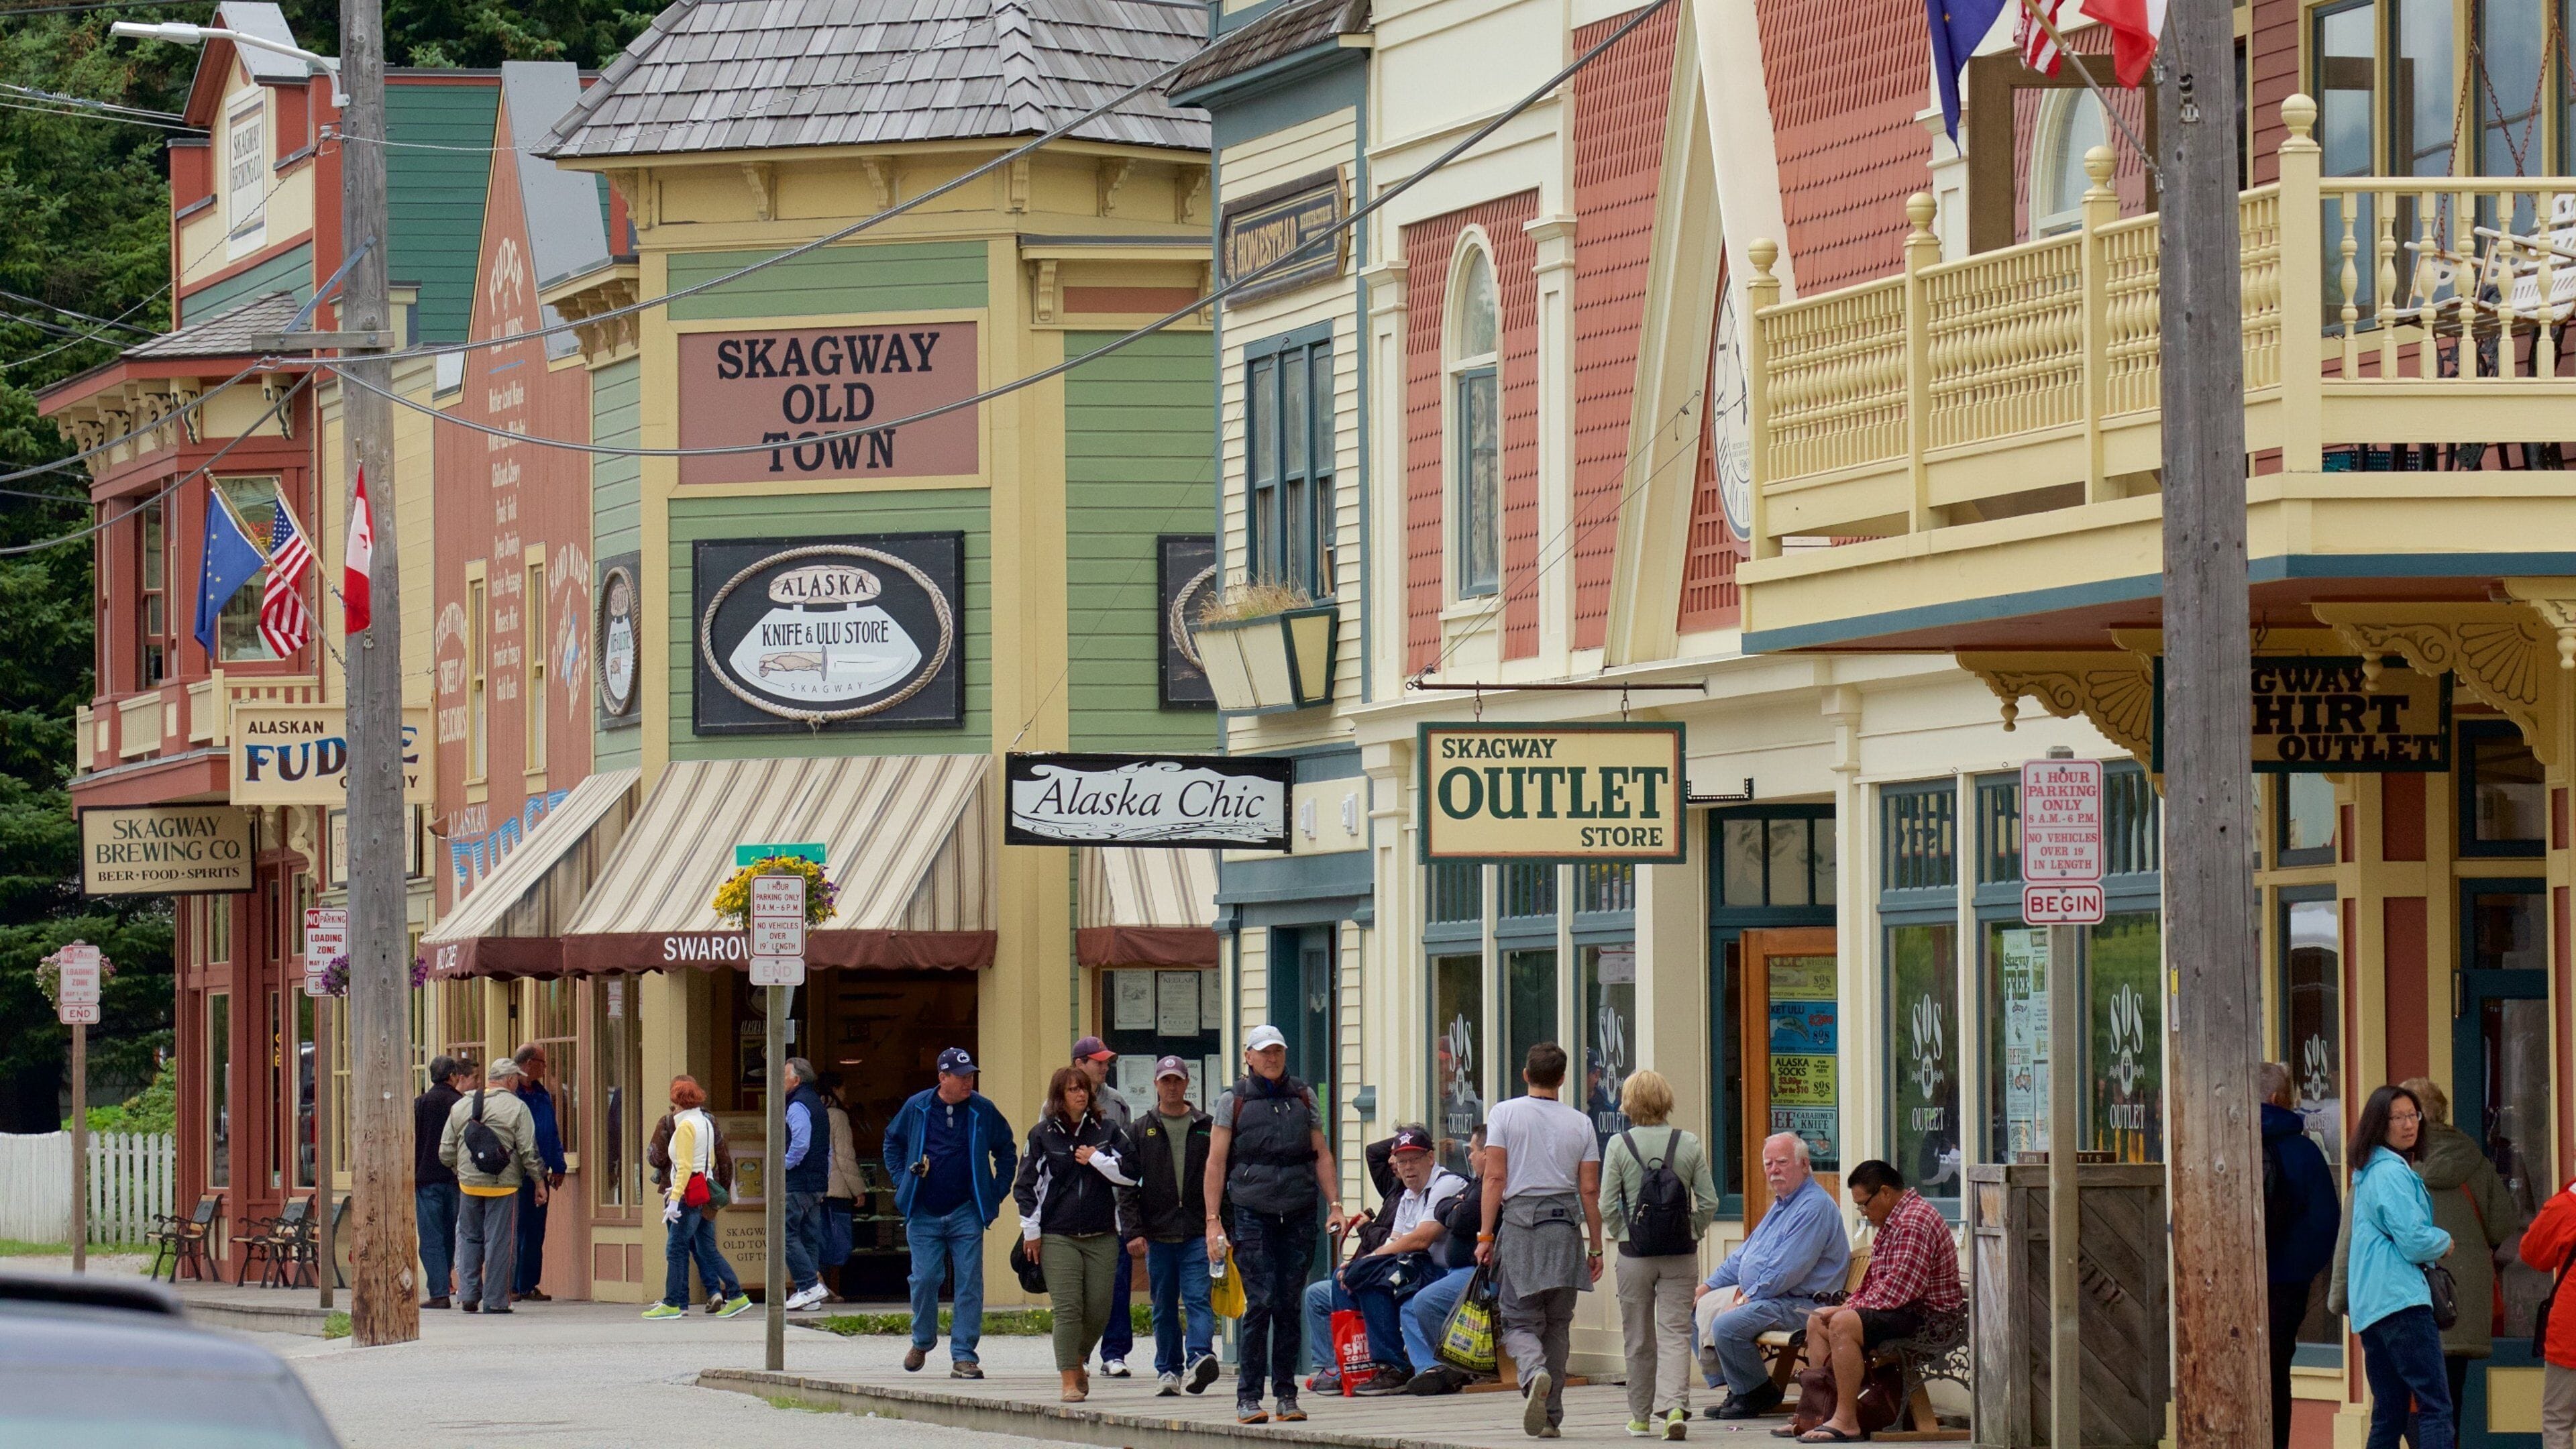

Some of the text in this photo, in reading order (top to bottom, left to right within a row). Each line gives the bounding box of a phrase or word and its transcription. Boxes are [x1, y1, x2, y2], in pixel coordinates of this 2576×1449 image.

[233, 123, 260, 161] SKAGWAY
[232, 154, 263, 193] BREWING CO.
[1236, 215, 1297, 274] HOMESTEAD
[490, 237, 523, 317] FUDGE
[491, 315, 523, 355] ALL KINDS
[718, 332, 939, 380] SKAGWAY
[782, 382, 874, 424] OLD
[762, 429, 896, 472] TOWN
[549, 545, 568, 603] HAND
[570, 542, 588, 597] MADE
[781, 574, 867, 596] ALASKA
[552, 585, 571, 684] RIGHT
[762, 620, 889, 646] KNIFE & ULU STORE
[570, 631, 587, 722] HERE
[791, 681, 863, 694] SKAGWAY
[2251, 667, 2365, 694] GWAY
[438, 705, 466, 745] DELICIOUS
[2251, 694, 2410, 735] HIRT
[248, 720, 324, 734] ALASKAN
[246, 727, 419, 782] FUDE
[1442, 738, 1557, 759] SKAGWAY
[2277, 734, 2438, 762] OUTLET
[2034, 771, 2090, 784] 1 HOUR
[1031, 777, 1265, 818] Alaska Chic
[1438, 766, 1668, 820] OUTLET
[2028, 786, 2097, 797] PARKING
[2042, 799, 2083, 810] ONLY
[113, 816, 221, 840] SKAGWAY
[447, 805, 488, 839] ALASKAN
[2028, 814, 2034, 824] 8
[2078, 813, 2097, 822] P.M.
[1581, 826, 1663, 847] STORE
[2028, 833, 2097, 843] NO VEHICLES
[96, 840, 241, 864] BREWING CO.
[2041, 847, 2068, 856] OVER
[99, 867, 239, 881] BEER FOOD SPIRITS
[2034, 859, 2092, 870] IN LENGTH
[2031, 896, 2097, 913] BEGIN
[307, 913, 345, 925] NO PARKING
[311, 934, 343, 942] LOADING
[317, 946, 336, 954] ZONE
[762, 966, 792, 977] END
[70, 1009, 91, 1018] END
[1770, 1005, 1805, 1014] KET ULU
[2110, 983, 2143, 1055] SOS
[740, 1020, 761, 1036] ALASKA
[1599, 1006, 1625, 1069] SOS
[1913, 994, 1943, 1061] SOS
[1449, 1013, 1472, 1072] SOS
[1775, 1058, 1809, 1067] ALASKA
[2304, 1033, 2328, 1077] SOS
[1778, 1067, 1807, 1077] SOCKS
[1813, 1081, 1830, 1091] SOS
[1448, 1113, 1472, 1134] OUTLET
[1598, 1111, 1625, 1134] OUTLET
[1801, 1120, 1829, 1129] KNIFE
[1912, 1107, 1945, 1131] OUTLET
[2110, 1104, 2145, 1129] OUTLET
[727, 1227, 767, 1238] SKAGWA
[723, 1240, 745, 1250] OLD
